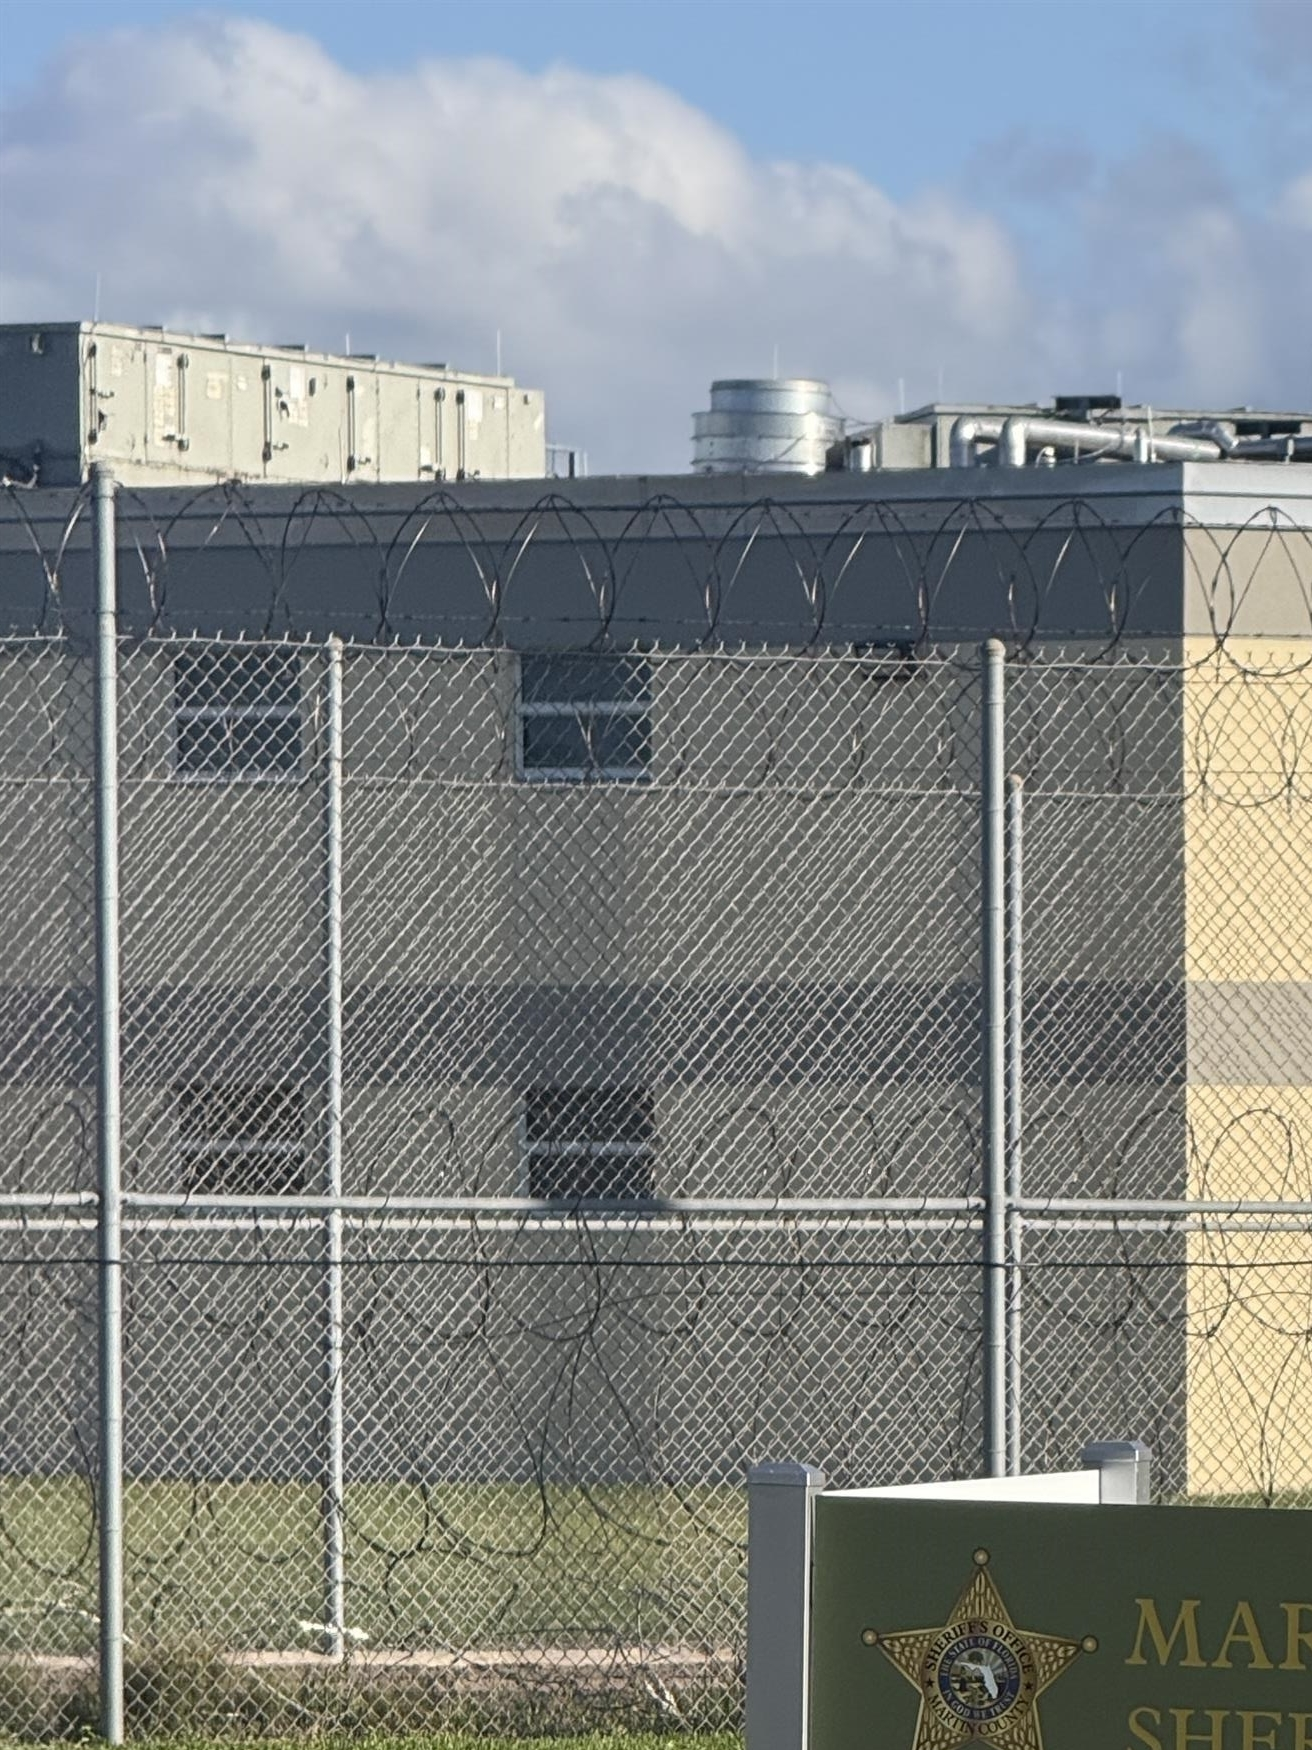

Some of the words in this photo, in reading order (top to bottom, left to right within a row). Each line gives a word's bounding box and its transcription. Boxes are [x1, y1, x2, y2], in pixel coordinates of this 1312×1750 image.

[947, 1638, 976, 1659] STATE
[977, 1637, 992, 1648] OF
[993, 1624, 1033, 1674] OFFICE
[929, 1694, 975, 1736] MARTIN
[978, 1699, 1029, 1736] COUNTY
[951, 1700, 971, 1718] GOD
[973, 1709, 988, 1720] WE
[988, 1692, 1015, 1717] TRUST
